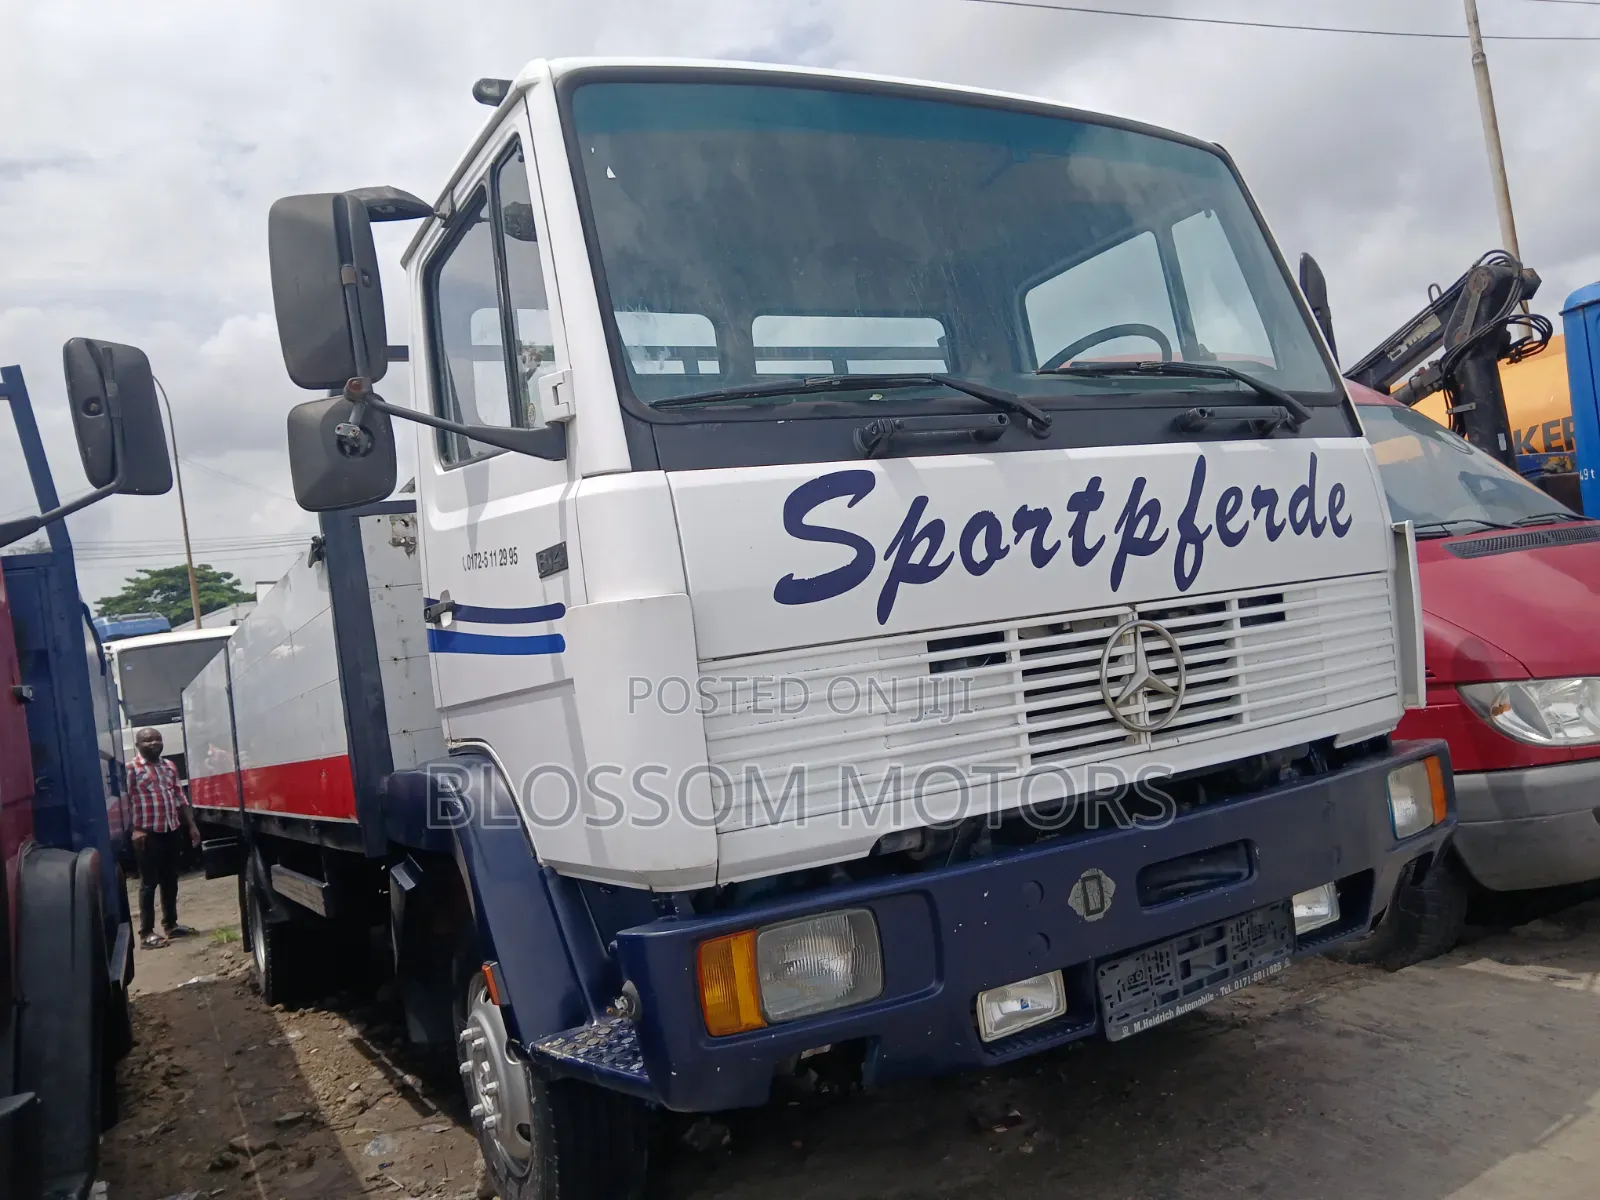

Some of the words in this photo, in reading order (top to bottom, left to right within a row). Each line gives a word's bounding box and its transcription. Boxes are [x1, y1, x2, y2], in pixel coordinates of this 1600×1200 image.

[773, 452, 1353, 625] Sportpferde
[466, 551, 489, 571] 0172-5
[489, 550, 498, 567] 11
[499, 548, 508, 566] 29
[508, 546, 518, 566] 95
[1175, 992, 1215, 1016] Automobile
